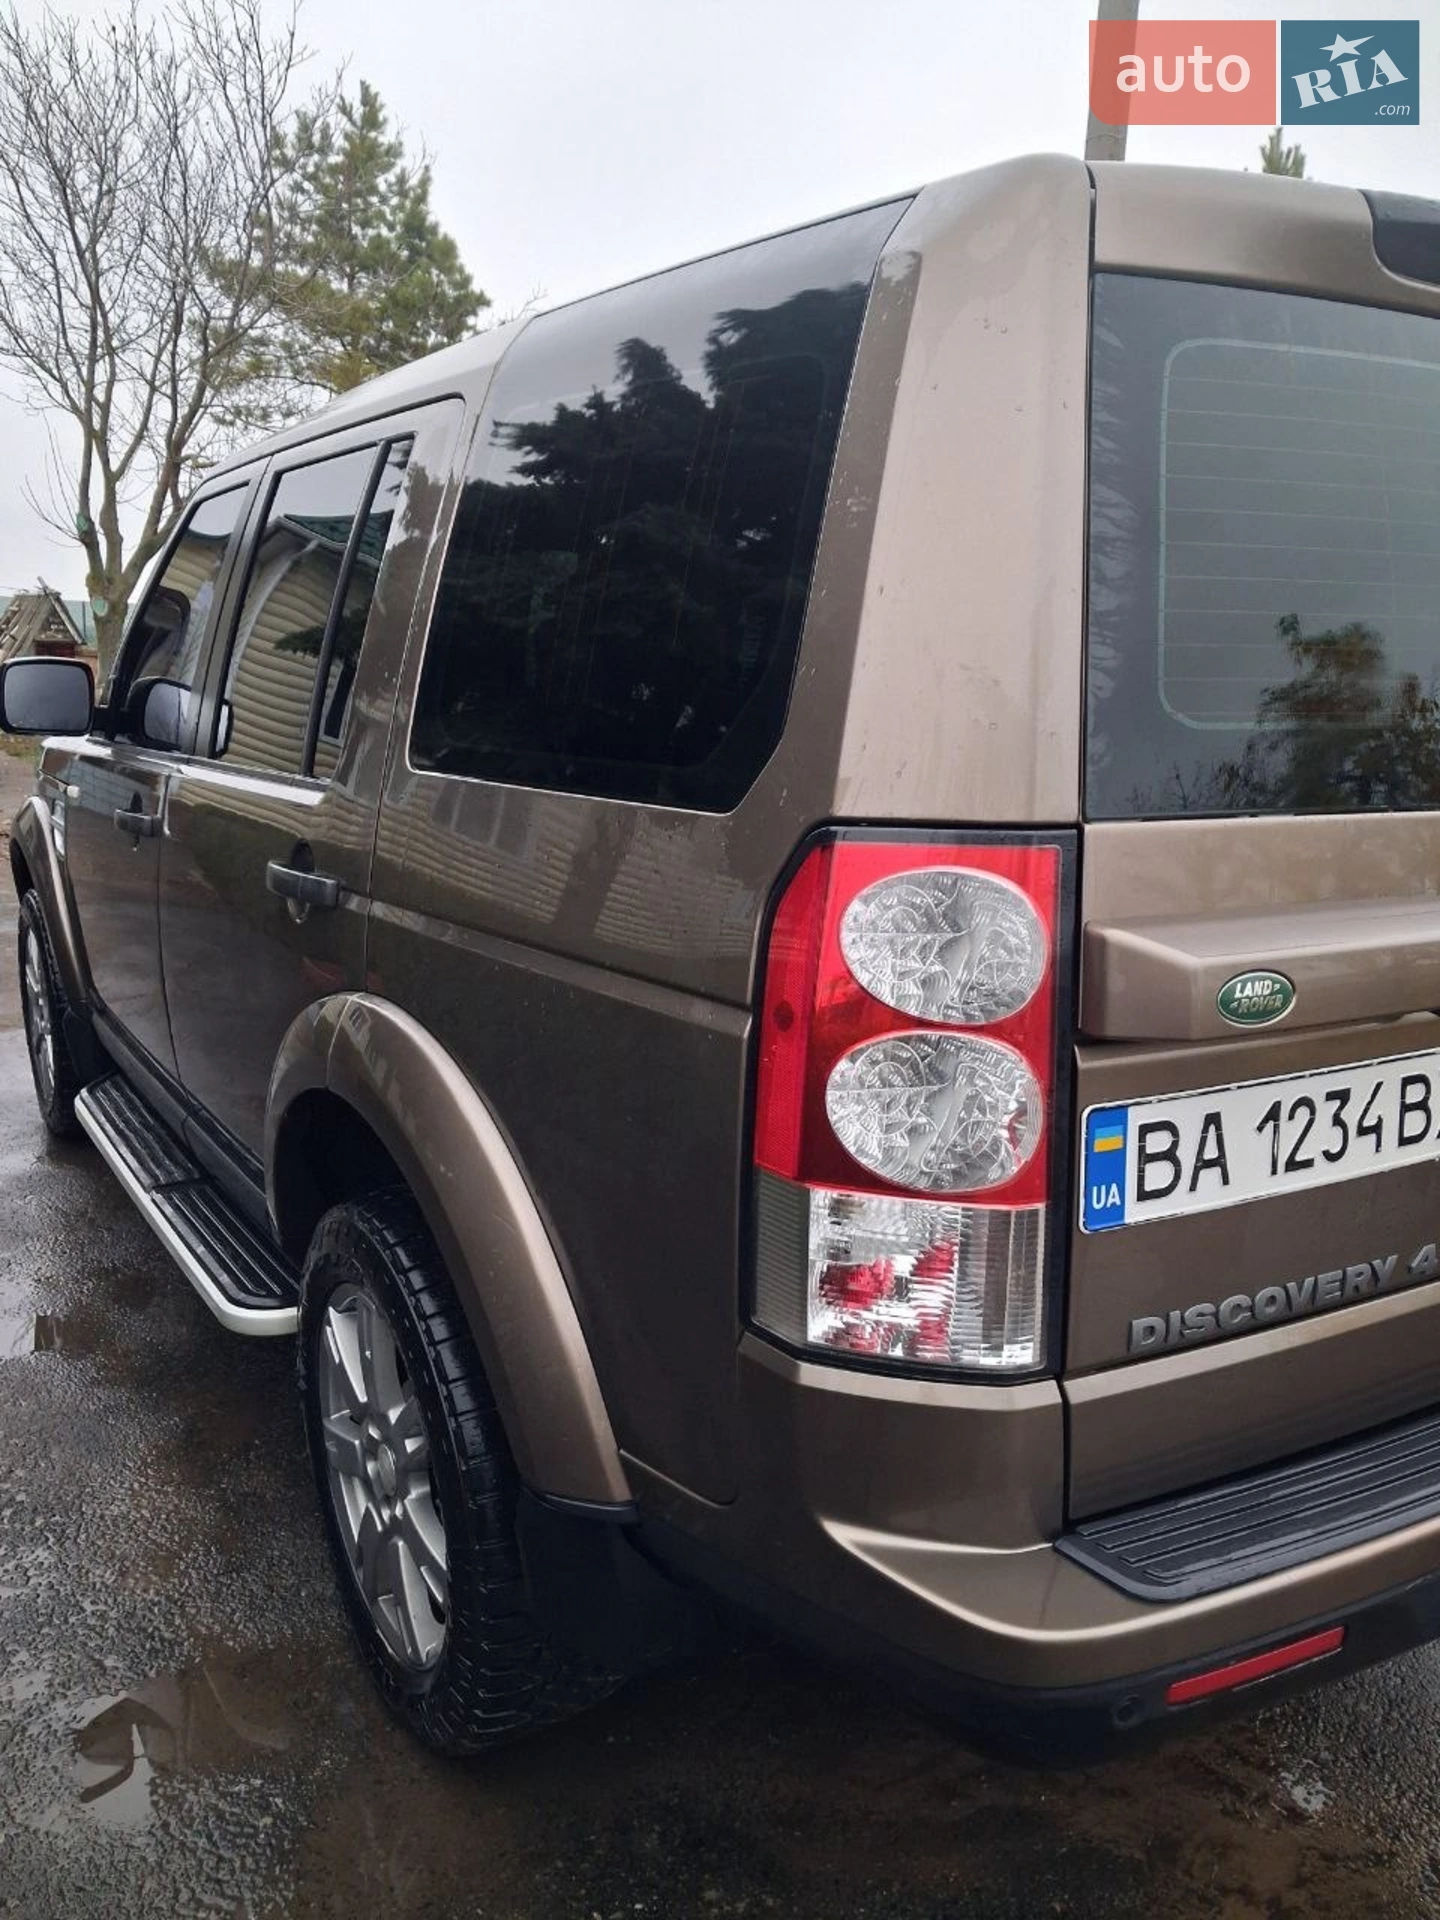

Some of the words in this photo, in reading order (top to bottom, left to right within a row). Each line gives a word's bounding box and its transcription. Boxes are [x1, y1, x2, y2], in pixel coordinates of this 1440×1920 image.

[1234, 979, 1273, 998] LAND
[1238, 994, 1284, 1013] ROVER
[1136, 1111, 1230, 1202] BA
[1256, 1081, 1384, 1176] 1234
[1398, 1073, 1440, 1147] B
[1092, 1183, 1121, 1209] UA
[1128, 1254, 1398, 1352] DISCOVERY
[1407, 1243, 1438, 1277] 4
